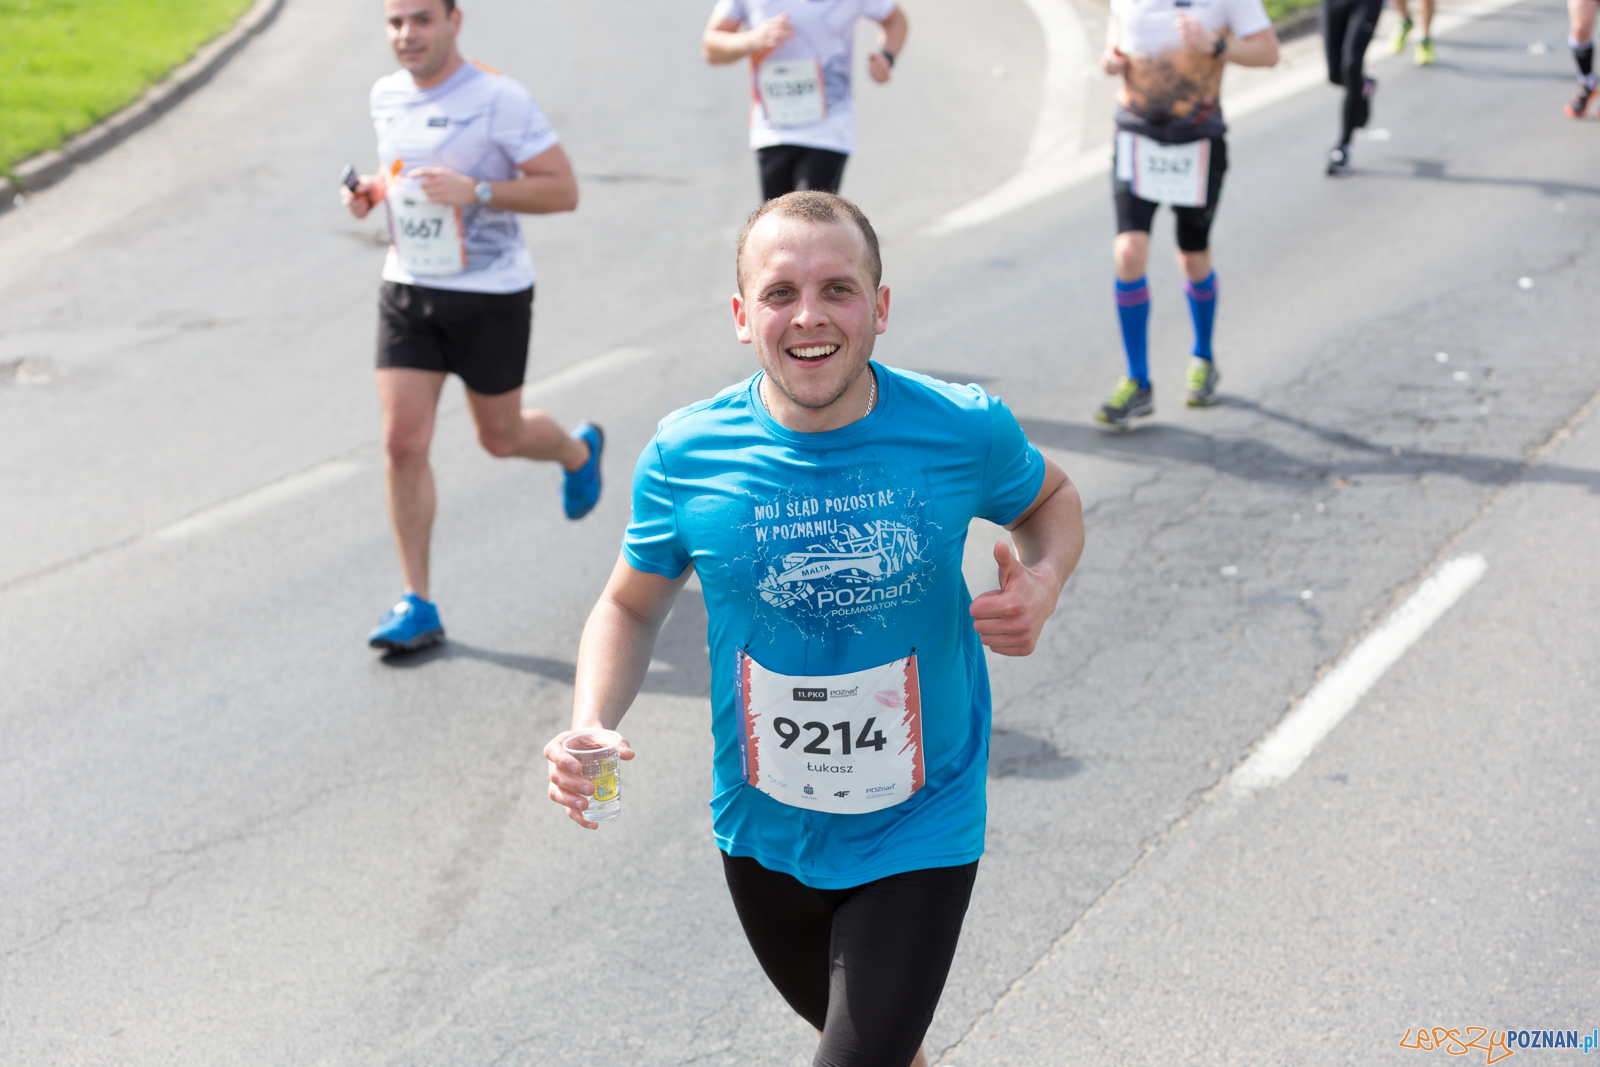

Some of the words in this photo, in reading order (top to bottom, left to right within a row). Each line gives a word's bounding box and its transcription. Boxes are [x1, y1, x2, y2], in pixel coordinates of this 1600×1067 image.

[398, 216, 444, 240] 1667
[825, 489, 895, 514] POZOSTAŁ
[755, 526, 769, 543] W
[772, 518, 838, 541] POZNANIU
[801, 564, 831, 577] MALTA
[831, 600, 898, 617] PÓŁMARATON
[773, 716, 887, 756] 9214
[807, 762, 854, 774] Łukasz
[833, 790, 850, 798] 4F
